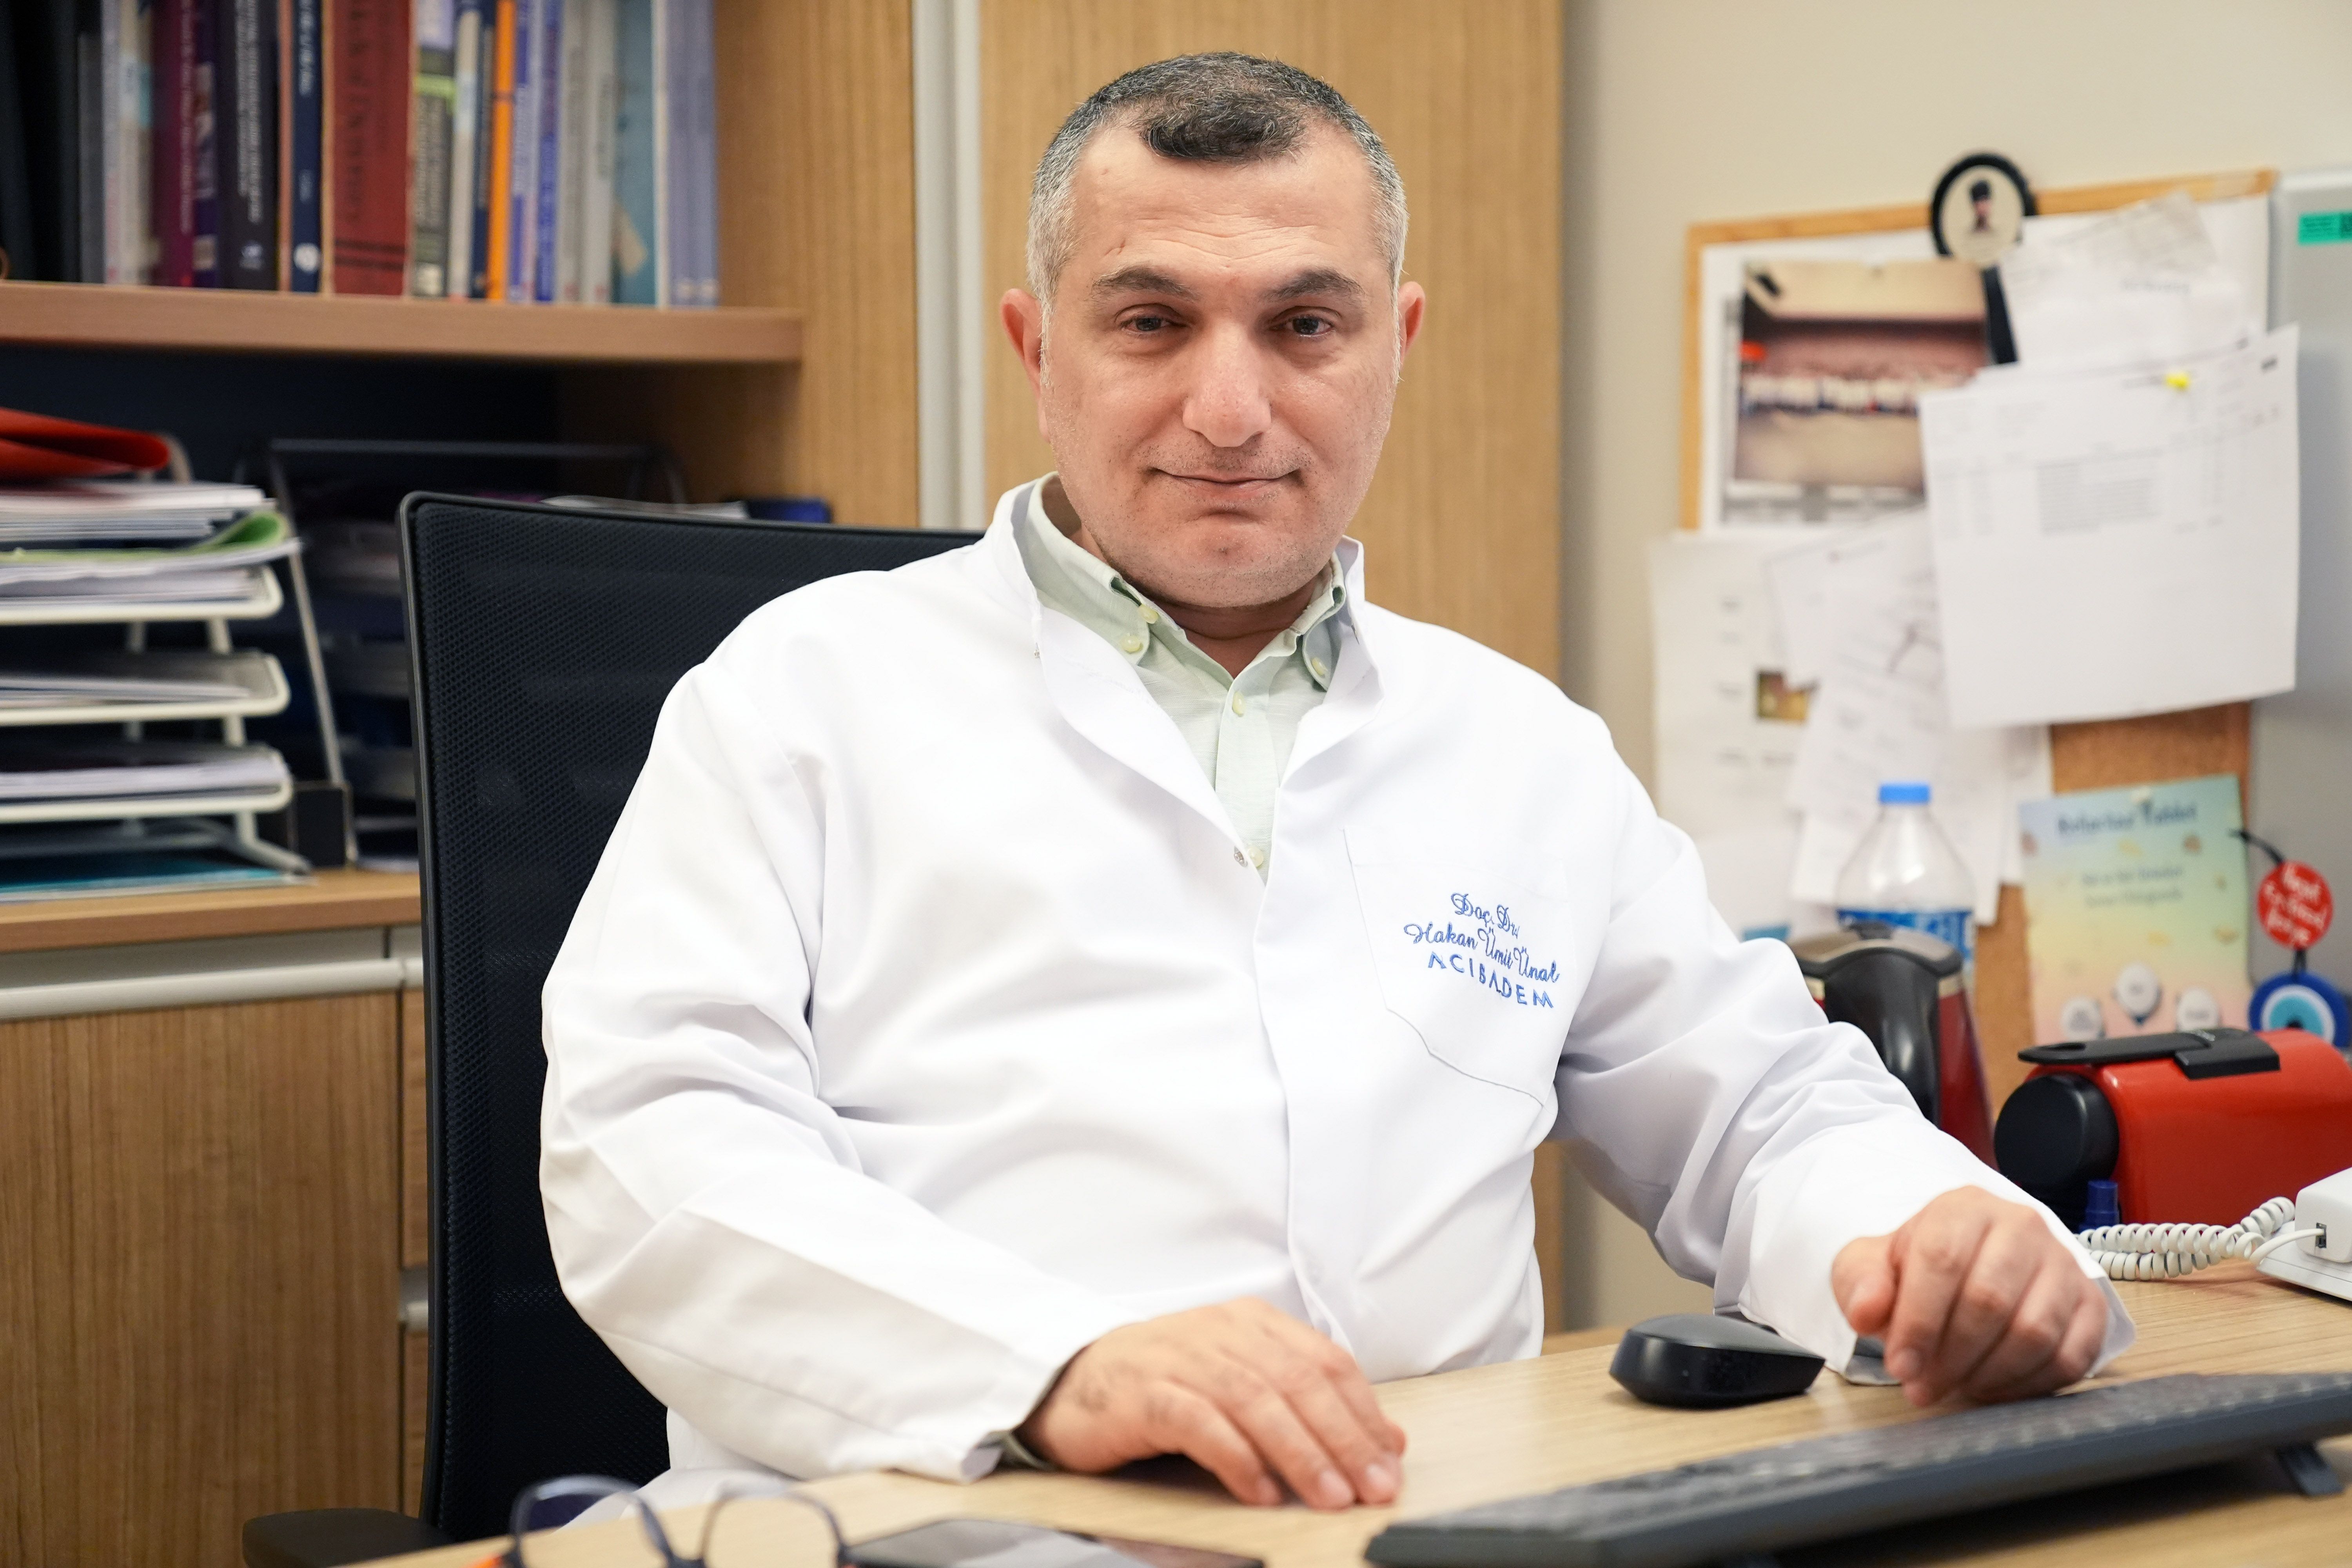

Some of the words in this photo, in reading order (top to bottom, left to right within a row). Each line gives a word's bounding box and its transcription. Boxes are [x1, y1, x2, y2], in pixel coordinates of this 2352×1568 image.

[1404, 921, 1478, 950] Hakan
[1477, 927, 1513, 969] Ümit
[1514, 946, 1560, 983] Ünal
[1428, 951, 1553, 1009] ACIBADEM
